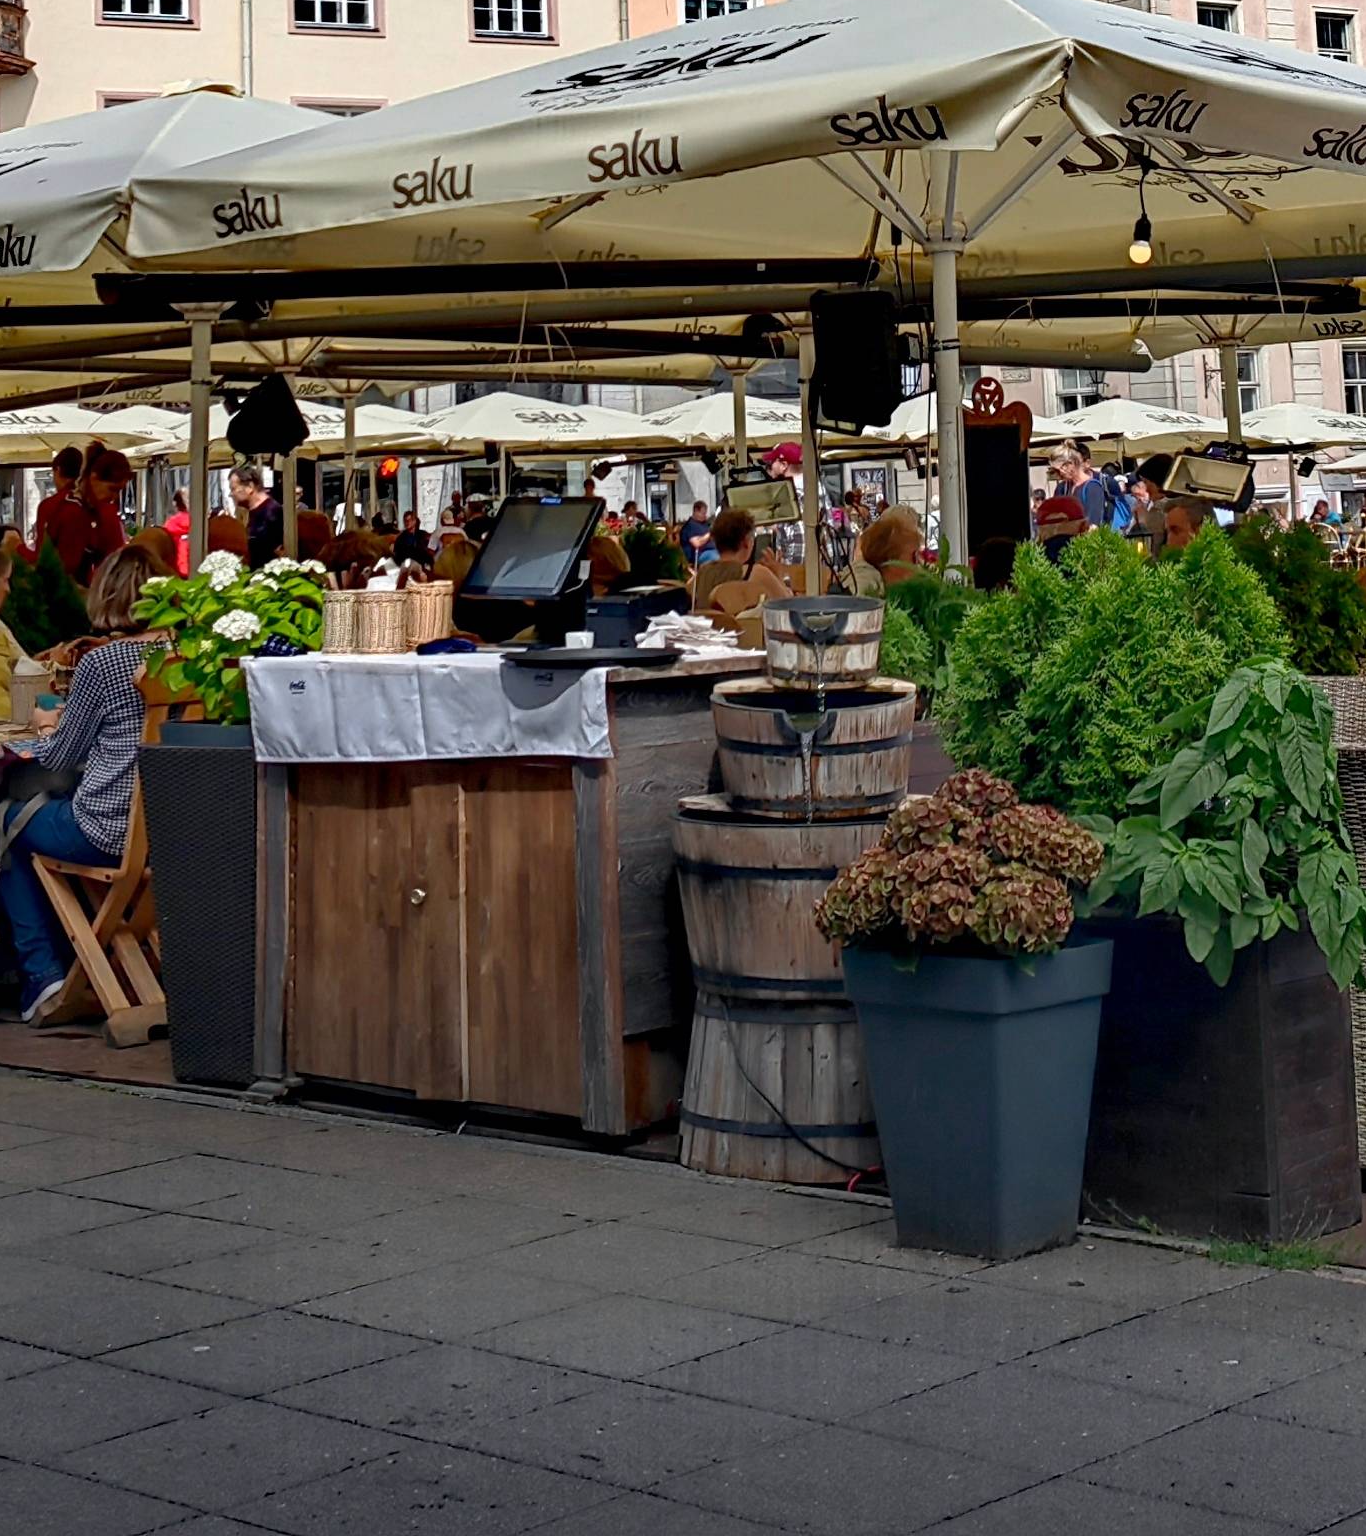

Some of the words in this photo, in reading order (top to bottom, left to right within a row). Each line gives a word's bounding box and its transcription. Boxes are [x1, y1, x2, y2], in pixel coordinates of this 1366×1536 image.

[520, 32, 830, 98] saku
[829, 94, 948, 147] saku
[1119, 88, 1208, 134] saku
[392, 154, 474, 210] saku
[586, 128, 684, 183] saku
[212, 184, 283, 239] saku
[515, 410, 587, 424] saku
